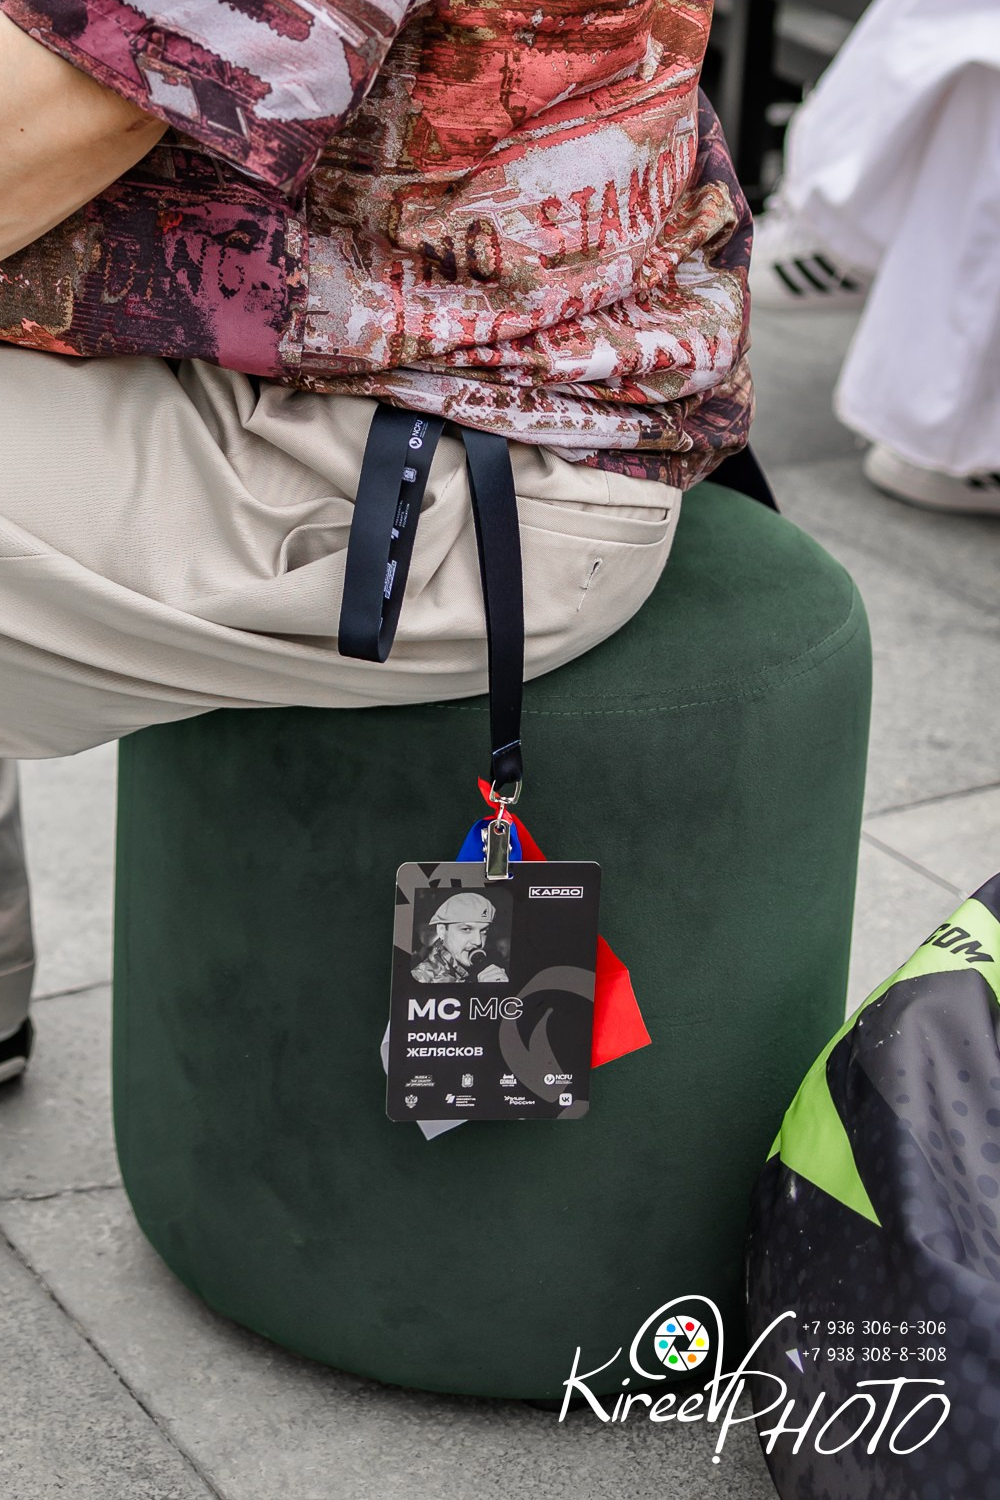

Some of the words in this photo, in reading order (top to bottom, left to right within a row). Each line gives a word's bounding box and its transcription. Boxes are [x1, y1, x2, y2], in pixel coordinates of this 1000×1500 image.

[531, 888, 581, 897] КАРДО
[407, 1031, 458, 1043] РОМАН
[406, 1046, 484, 1057] ЖЕЛЯСКОВ
